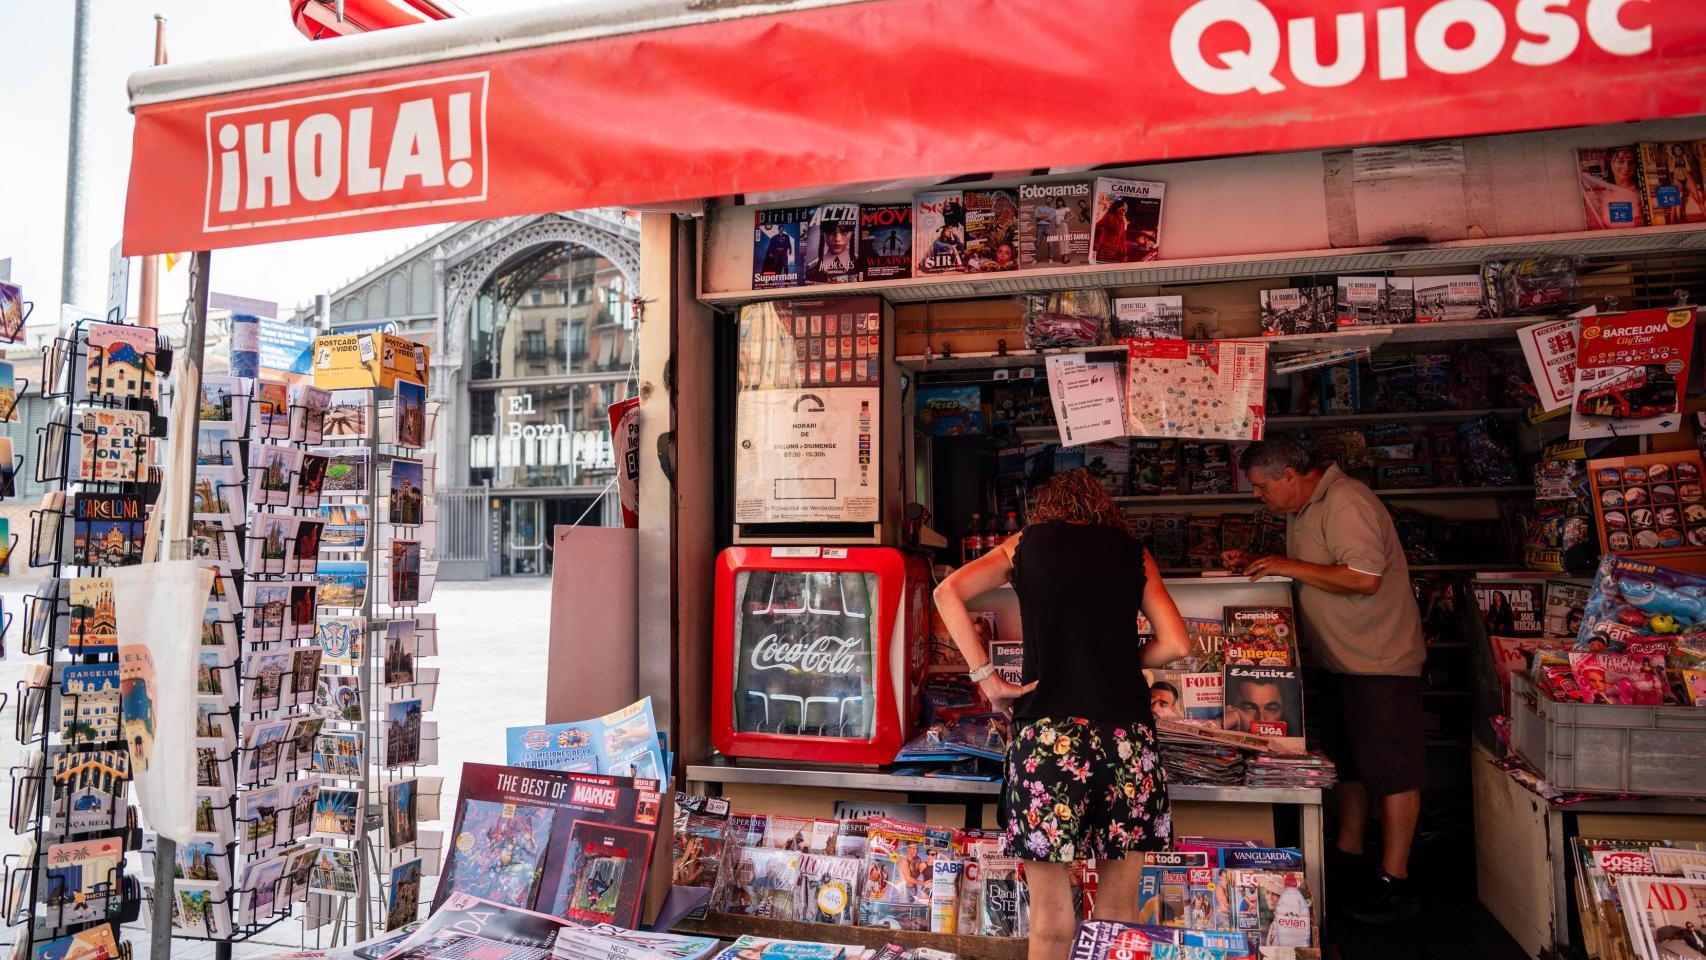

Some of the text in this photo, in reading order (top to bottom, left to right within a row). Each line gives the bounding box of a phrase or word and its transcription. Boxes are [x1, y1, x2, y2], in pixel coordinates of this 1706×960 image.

[218, 91, 474, 213] ¡HOLA!
[1019, 183, 1090, 198] Fotogramas
[754, 272, 798, 285] Superman
[1603, 323, 1669, 338] BARCELONA
[507, 394, 537, 415] El
[507, 422, 567, 441] Born
[79, 497, 139, 519] BARCELONA
[1234, 611, 1279, 620] Cannabis
[1513, 621, 1541, 631] KISZKA
[750, 633, 862, 675] Coca-Cola
[1230, 668, 1296, 679] Esquire
[1259, 726, 1283, 736] LIGA
[537, 750, 569, 758] MISIONES
[497, 773, 617, 808] THE BEST OF MARVEL
[1156, 852, 1181, 864] todo
[1234, 852, 1292, 860] VANGUARDIA
[1190, 869, 1212, 879] DIEZ
[1648, 883, 1687, 911] AD
[1278, 918, 1306, 927] evian
